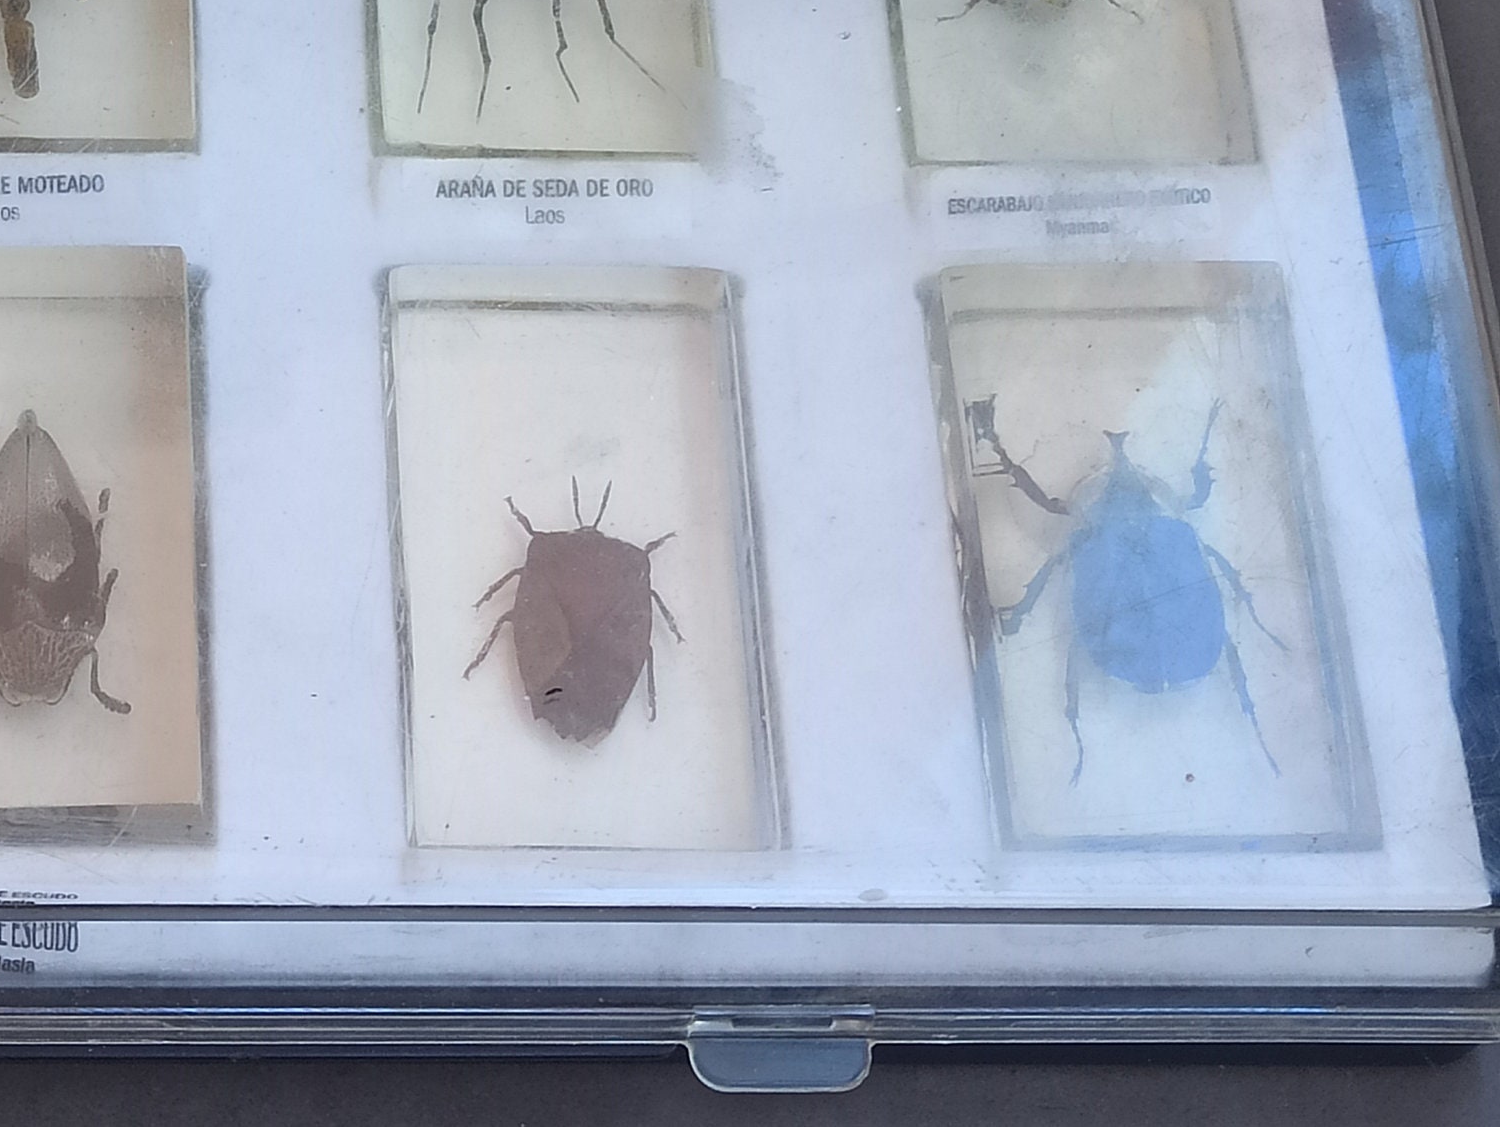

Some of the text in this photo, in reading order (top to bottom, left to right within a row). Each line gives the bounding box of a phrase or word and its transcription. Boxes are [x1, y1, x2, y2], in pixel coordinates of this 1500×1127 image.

[18, 174, 105, 194] MOTEADO
[435, 176, 654, 199] ARAÑA DE SEDA DE ORO
[524, 206, 566, 225] Laos
[948, 195, 1045, 216] ESCARABAJO
[11, 890, 80, 900] ESCUDO
